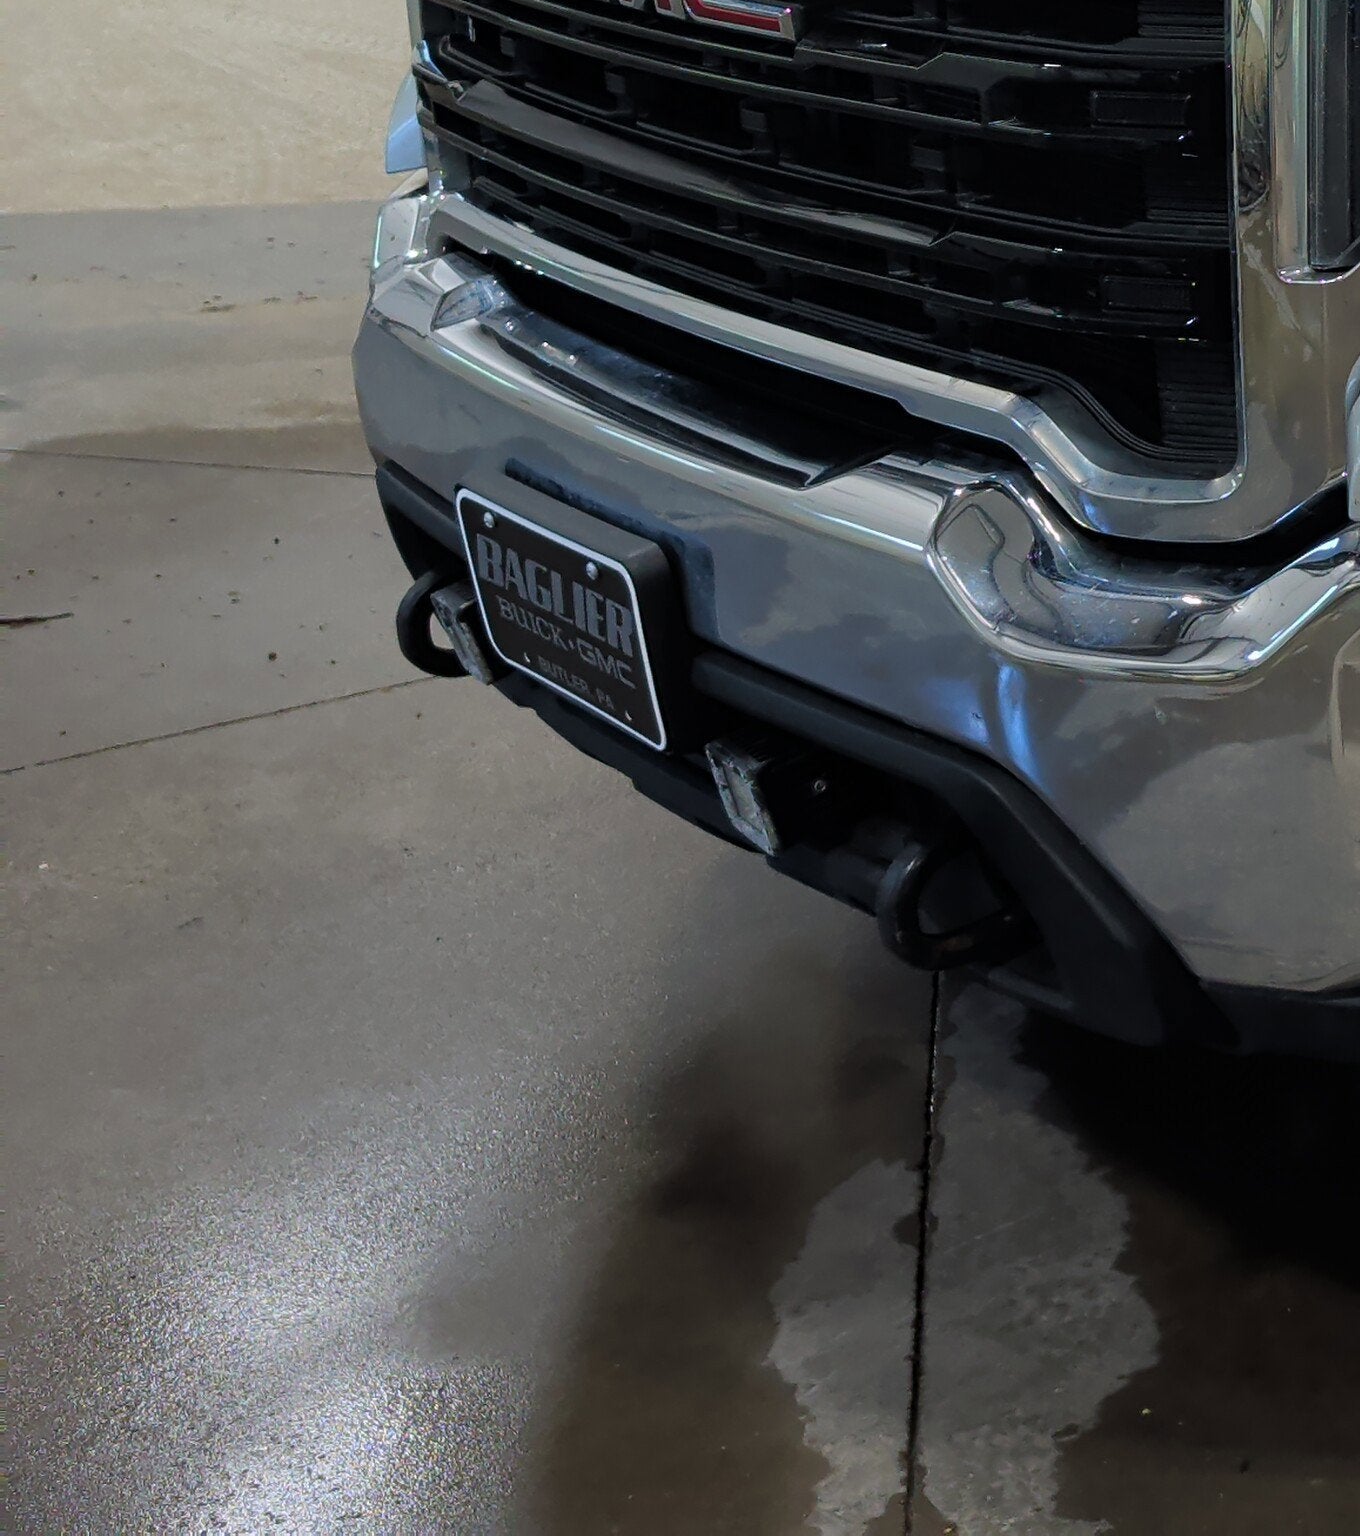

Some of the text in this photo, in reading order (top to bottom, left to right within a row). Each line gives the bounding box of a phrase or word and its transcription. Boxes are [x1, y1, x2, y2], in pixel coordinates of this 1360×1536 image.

[476, 533, 634, 658] BAGLIER
[496, 595, 636, 690] BUICK GMC
